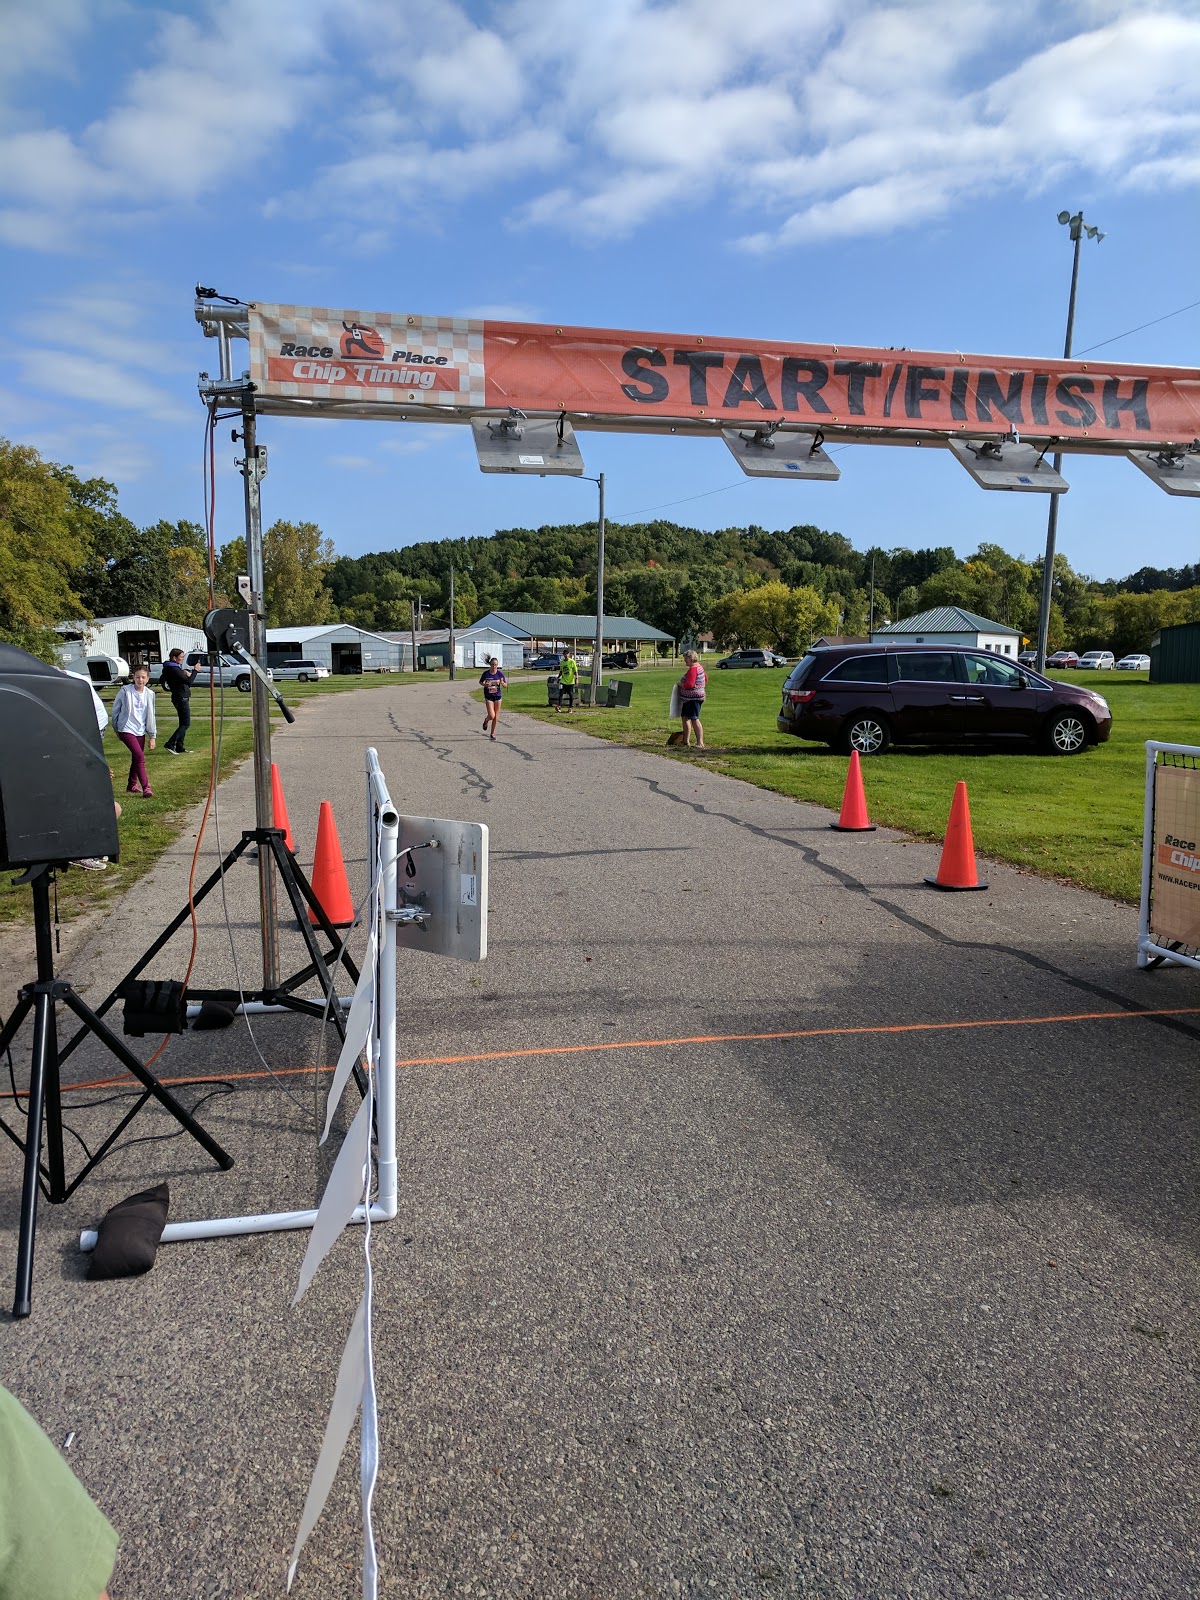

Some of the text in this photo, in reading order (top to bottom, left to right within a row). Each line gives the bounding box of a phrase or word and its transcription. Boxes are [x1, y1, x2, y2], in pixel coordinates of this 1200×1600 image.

[279, 342, 448, 366] Race Place
[292, 361, 437, 389] Chip Timing
[620, 345, 1151, 431] START/FINISH
[1164, 834, 1196, 851] Race
[1170, 850, 1200, 872] Chip
